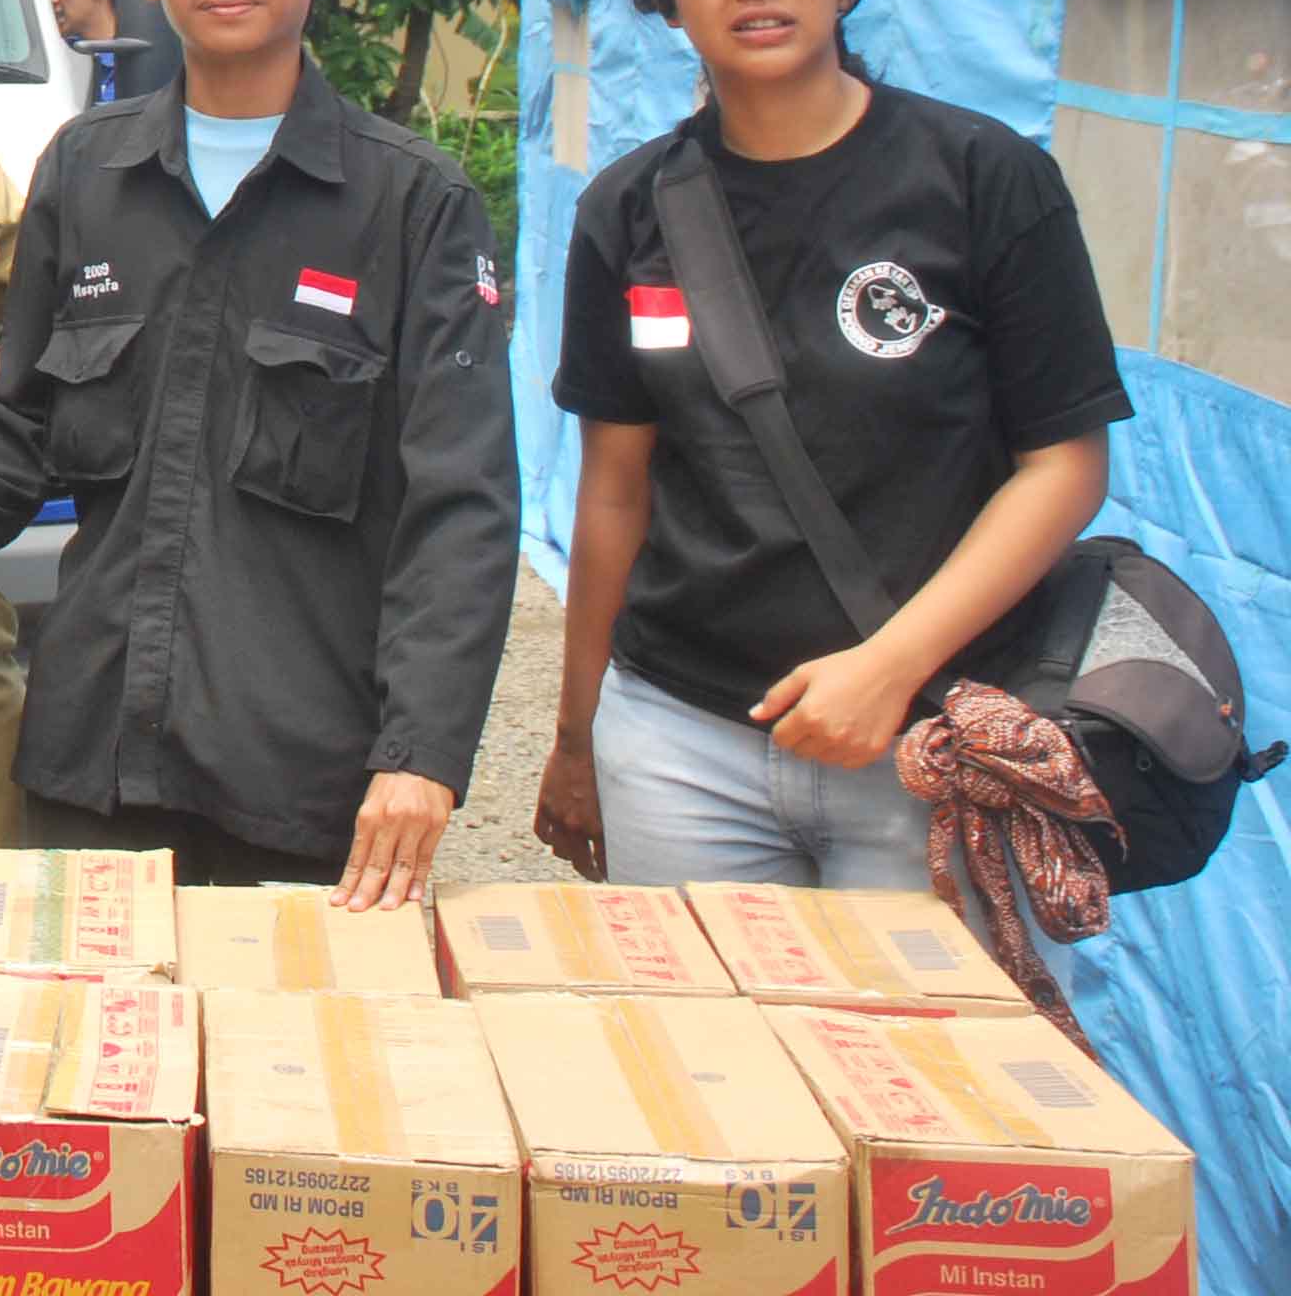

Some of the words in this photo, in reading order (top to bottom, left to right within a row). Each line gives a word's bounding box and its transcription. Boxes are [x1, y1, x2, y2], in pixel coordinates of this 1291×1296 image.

[250, 1192, 278, 1212] MD
[283, 1195, 301, 1213] RI
[308, 1198, 364, 1218] BPOM
[620, 1188, 678, 1209] BPOM
[940, 1264, 966, 1286] Mi
[972, 1265, 1045, 1289] Instan
